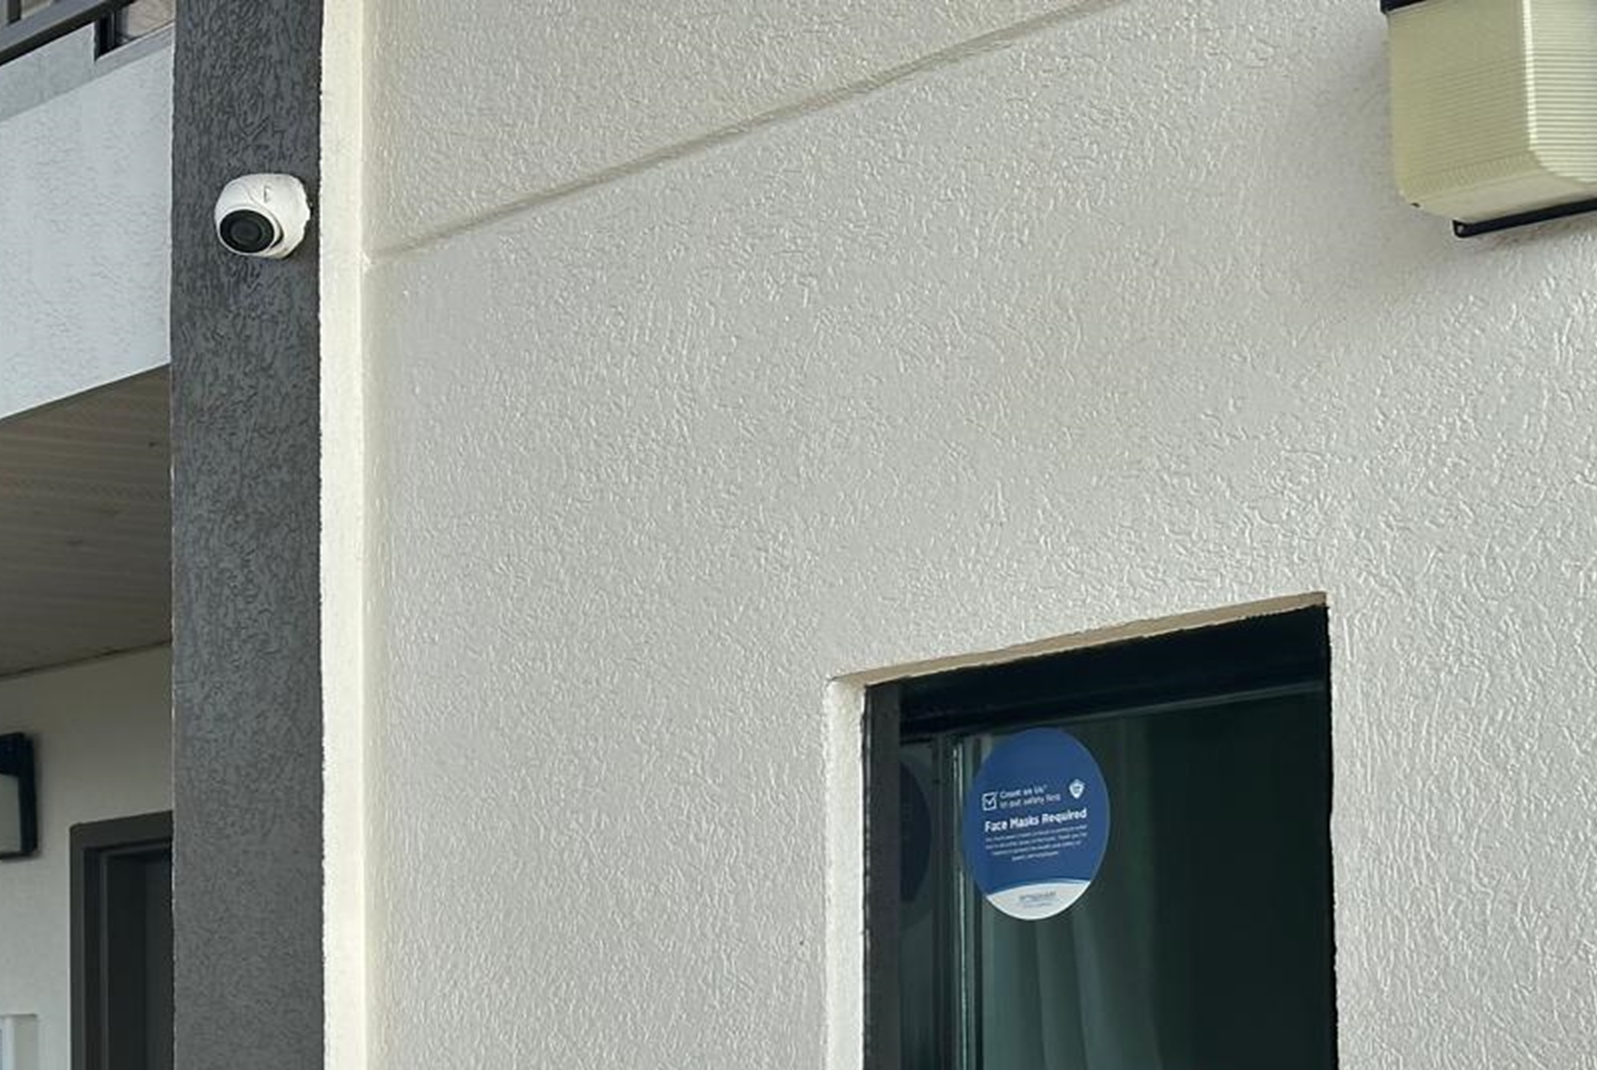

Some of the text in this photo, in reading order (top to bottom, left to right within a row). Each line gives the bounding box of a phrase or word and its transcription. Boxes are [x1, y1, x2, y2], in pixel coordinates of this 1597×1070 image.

[984, 820, 1008, 833] Face
[1009, 815, 1040, 830] Masks
[1041, 807, 1088, 824] Required
